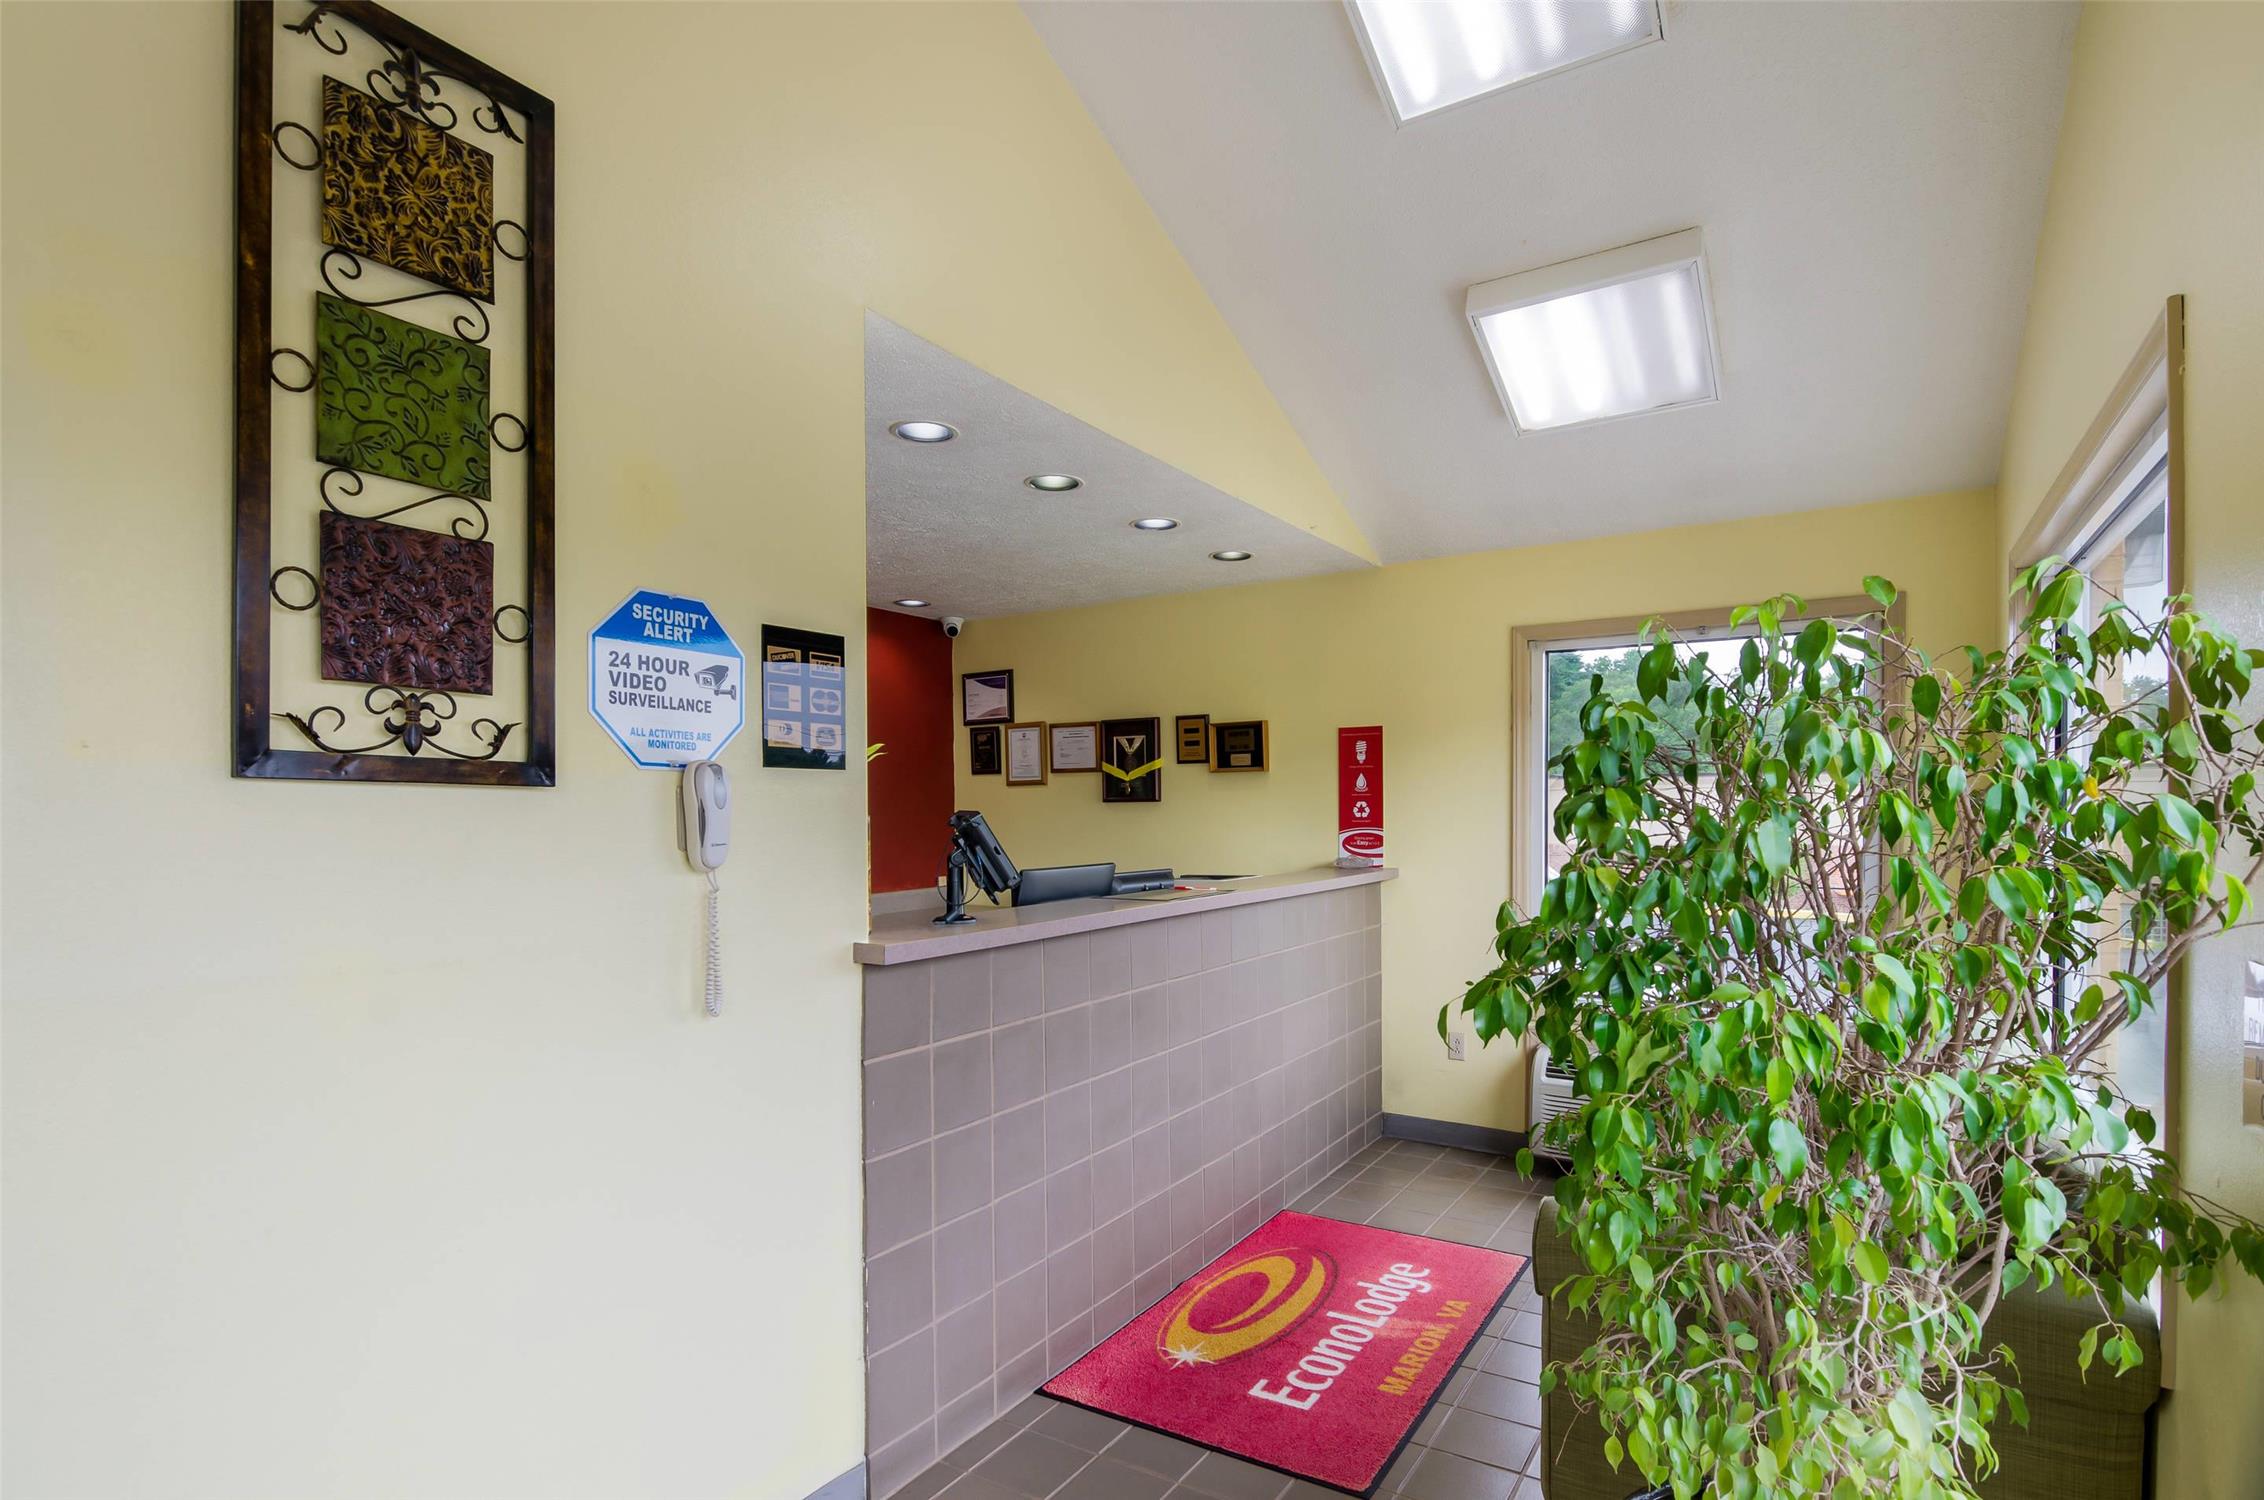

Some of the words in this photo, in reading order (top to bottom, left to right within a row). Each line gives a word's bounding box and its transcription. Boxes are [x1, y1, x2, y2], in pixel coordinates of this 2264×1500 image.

[632, 603, 709, 630] SECURITY
[643, 622, 693, 643] ALERT
[608, 650, 632, 669] 24
[637, 654, 690, 677] HOUR
[608, 670, 667, 692] VIDEO
[608, 690, 712, 714] SURVEILLANCE
[630, 727, 646, 737] ALL
[649, 728, 694, 741] ACTIVITIES
[696, 732, 712, 742] ARE
[648, 739, 697, 751] MONITORED
[1248, 1263, 1432, 1411] EconoLodge
[1377, 1323, 1458, 1397] MARION,
[1436, 1300, 1471, 1318] VA
